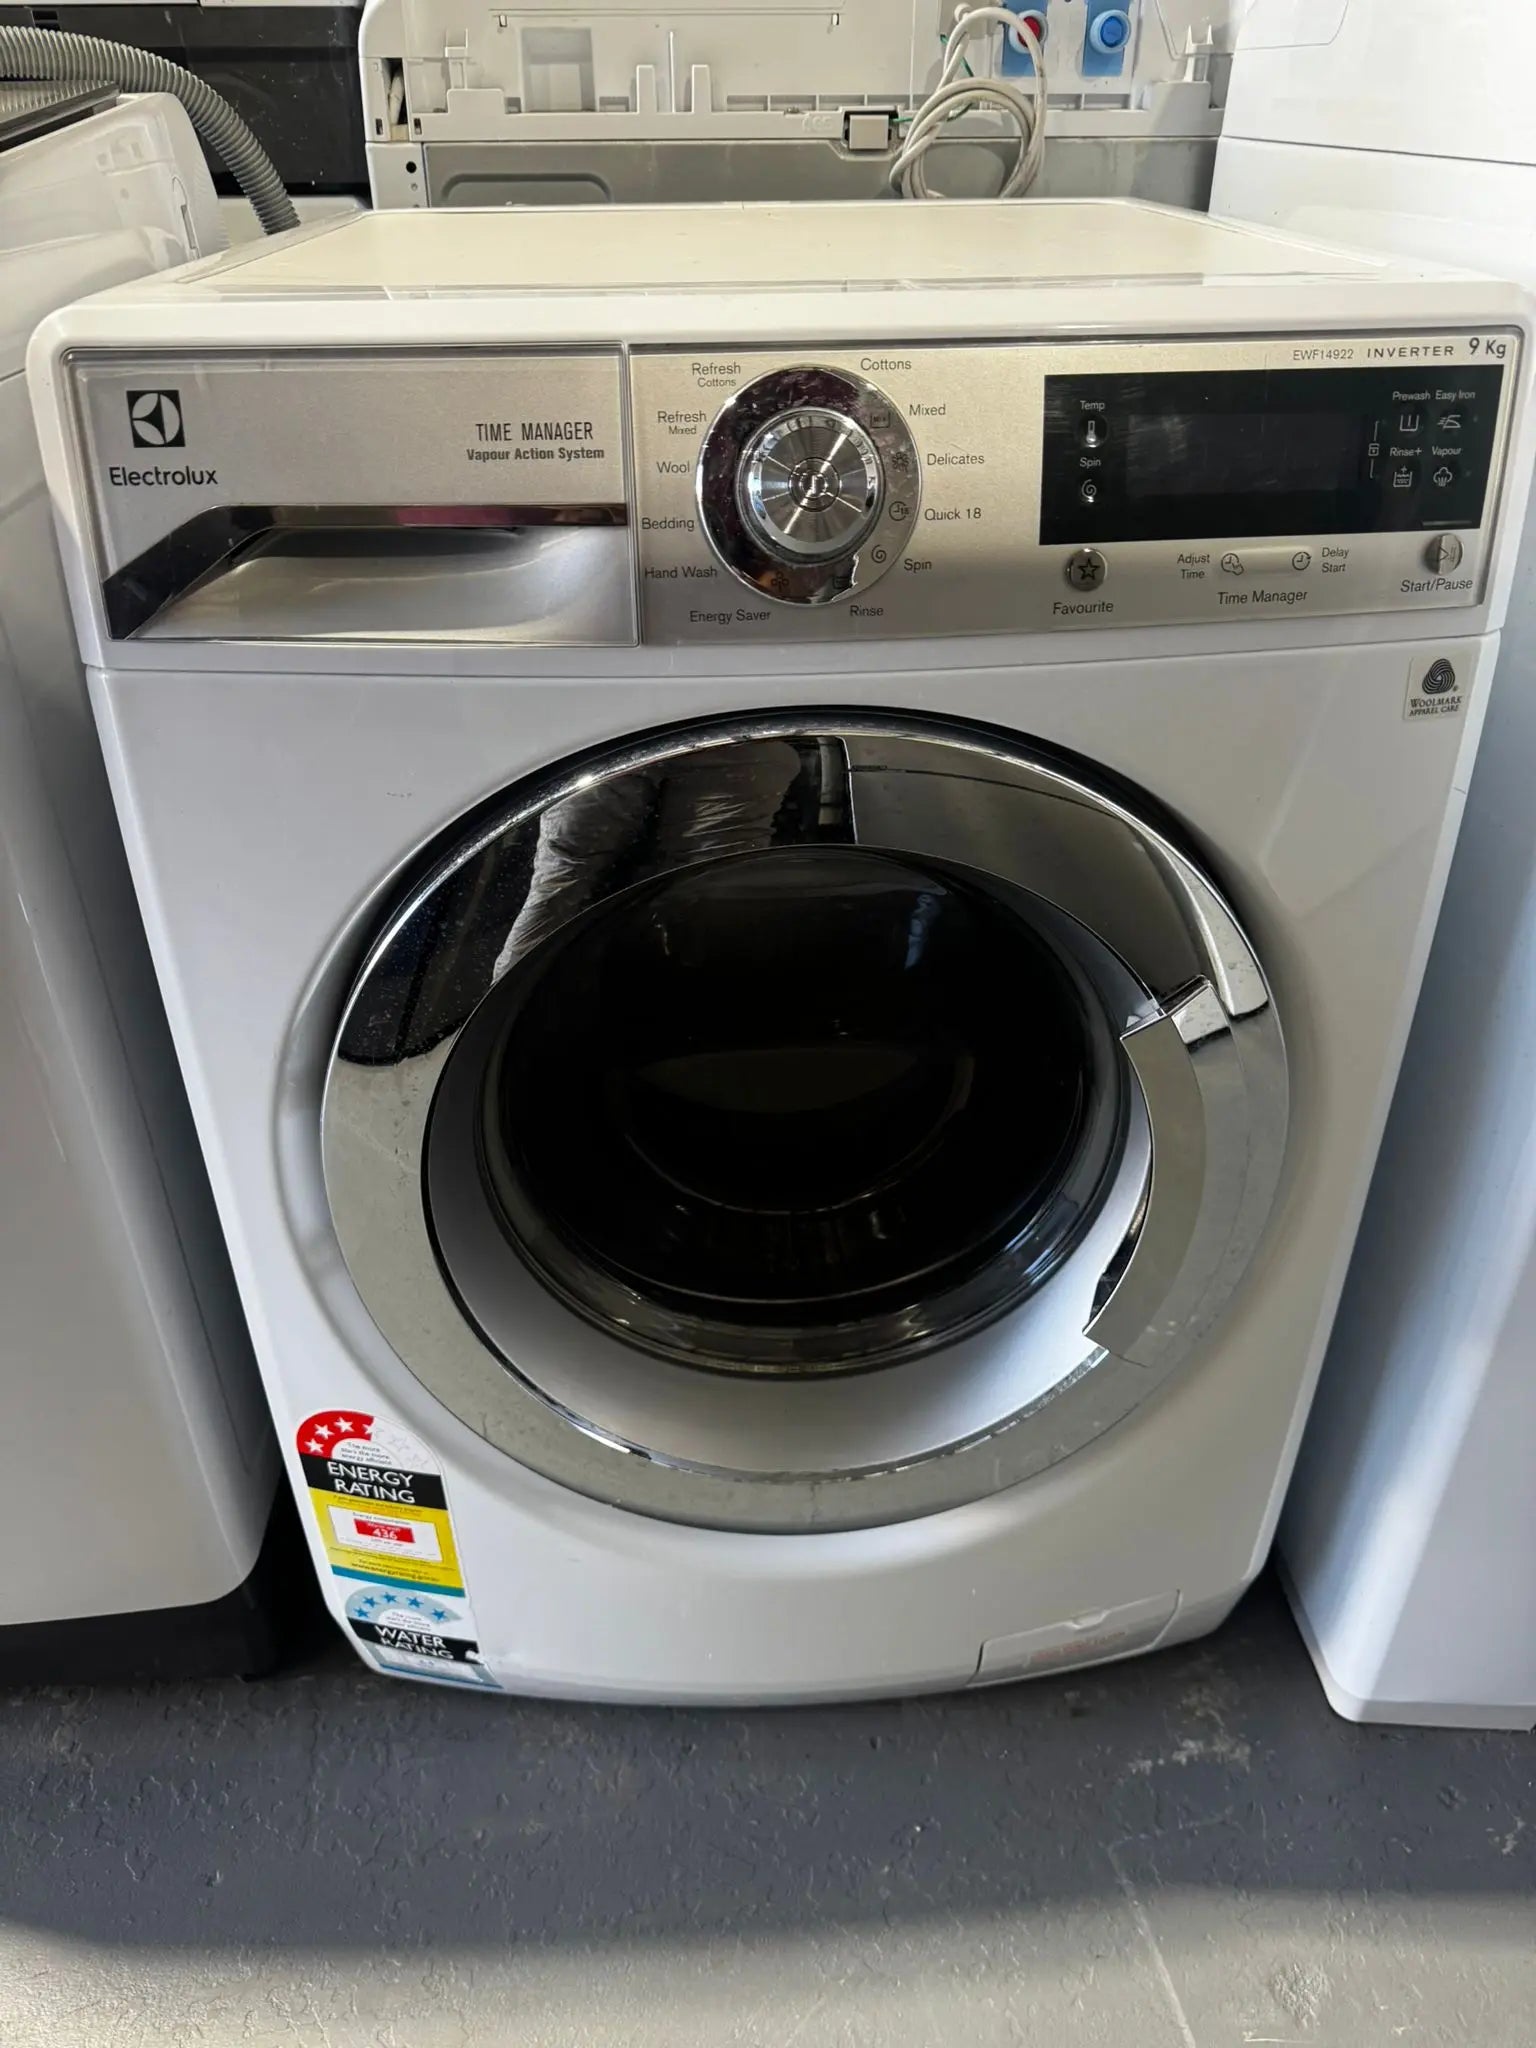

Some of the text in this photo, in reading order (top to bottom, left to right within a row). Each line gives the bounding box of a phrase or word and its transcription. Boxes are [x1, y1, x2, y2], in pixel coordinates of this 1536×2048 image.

[1293, 346, 1454, 361] EWF14922 INVERTER
[691, 362, 741, 375] Refresh
[860, 357, 912, 371] Cottons
[697, 378, 736, 388] Cottons
[1392, 389, 1476, 402] Prewash Easy Iron
[909, 404, 946, 416] Mixed
[1080, 400, 1106, 411] Temp
[657, 410, 707, 423] Refresh
[475, 421, 594, 442] TIME MANAGER
[668, 426, 697, 435] Mixed
[466, 446, 605, 463] Vapour Action System
[1431, 446, 1462, 457] Vapour
[926, 453, 985, 466] Delicates
[1080, 457, 1102, 468] Spin
[656, 461, 690, 474] Wool
[109, 466, 219, 487] Electrolux
[924, 507, 982, 521] Quick 18
[641, 516, 695, 532] Bedding
[1176, 553, 1211, 566] Adjust
[1321, 547, 1350, 560] Delay
[644, 565, 718, 579] Hand Wash
[903, 559, 933, 573] Spin
[1321, 562, 1346, 574] Start
[1181, 569, 1206, 580] Time
[1400, 578, 1474, 593] Start/Pause
[1217, 590, 1308, 606] Time Manager
[849, 605, 884, 617] Rinse
[1053, 601, 1114, 615] Favourite
[689, 609, 772, 625] Energy Saver
[1410, 696, 1462, 708] WOOLMARK
[327, 1460, 414, 1488] ENERGY
[333, 1479, 416, 1504] RATING
[374, 1624, 448, 1649] WATER
